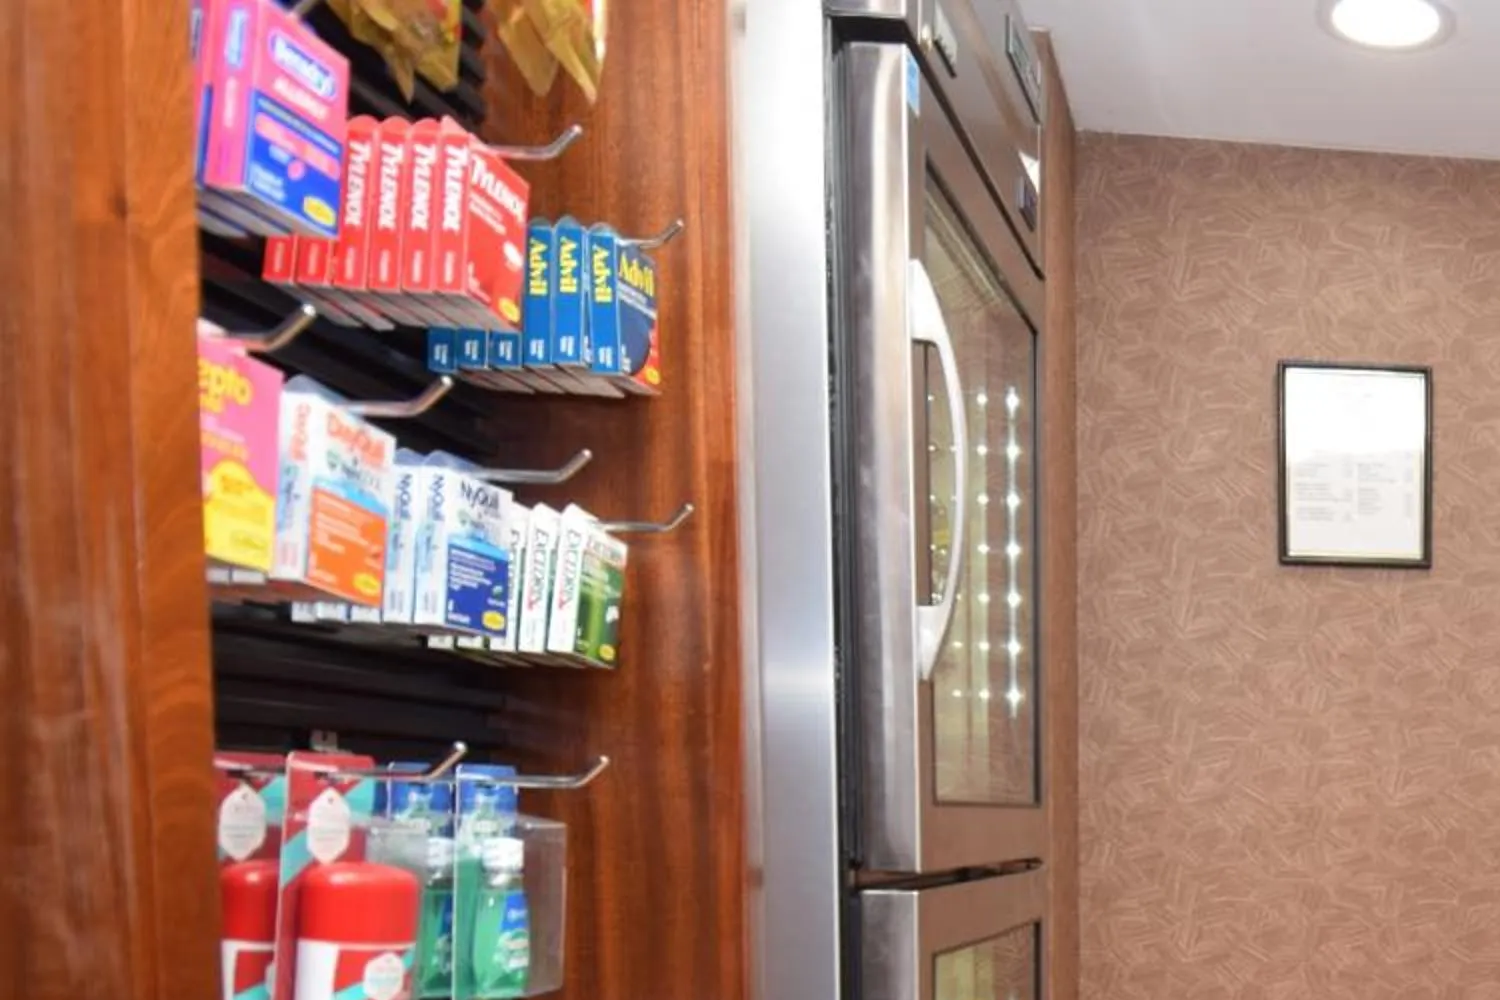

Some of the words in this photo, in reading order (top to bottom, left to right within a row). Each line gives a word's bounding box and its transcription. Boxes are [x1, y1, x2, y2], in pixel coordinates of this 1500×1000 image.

[378, 141, 404, 233] TYLENOL
[410, 141, 437, 232] TYLENOL
[441, 142, 469, 233] TYLENOL
[528, 236, 549, 297] Advil
[559, 235, 579, 294] Advil
[592, 243, 613, 303] Advil
[618, 251, 655, 297] Advil
